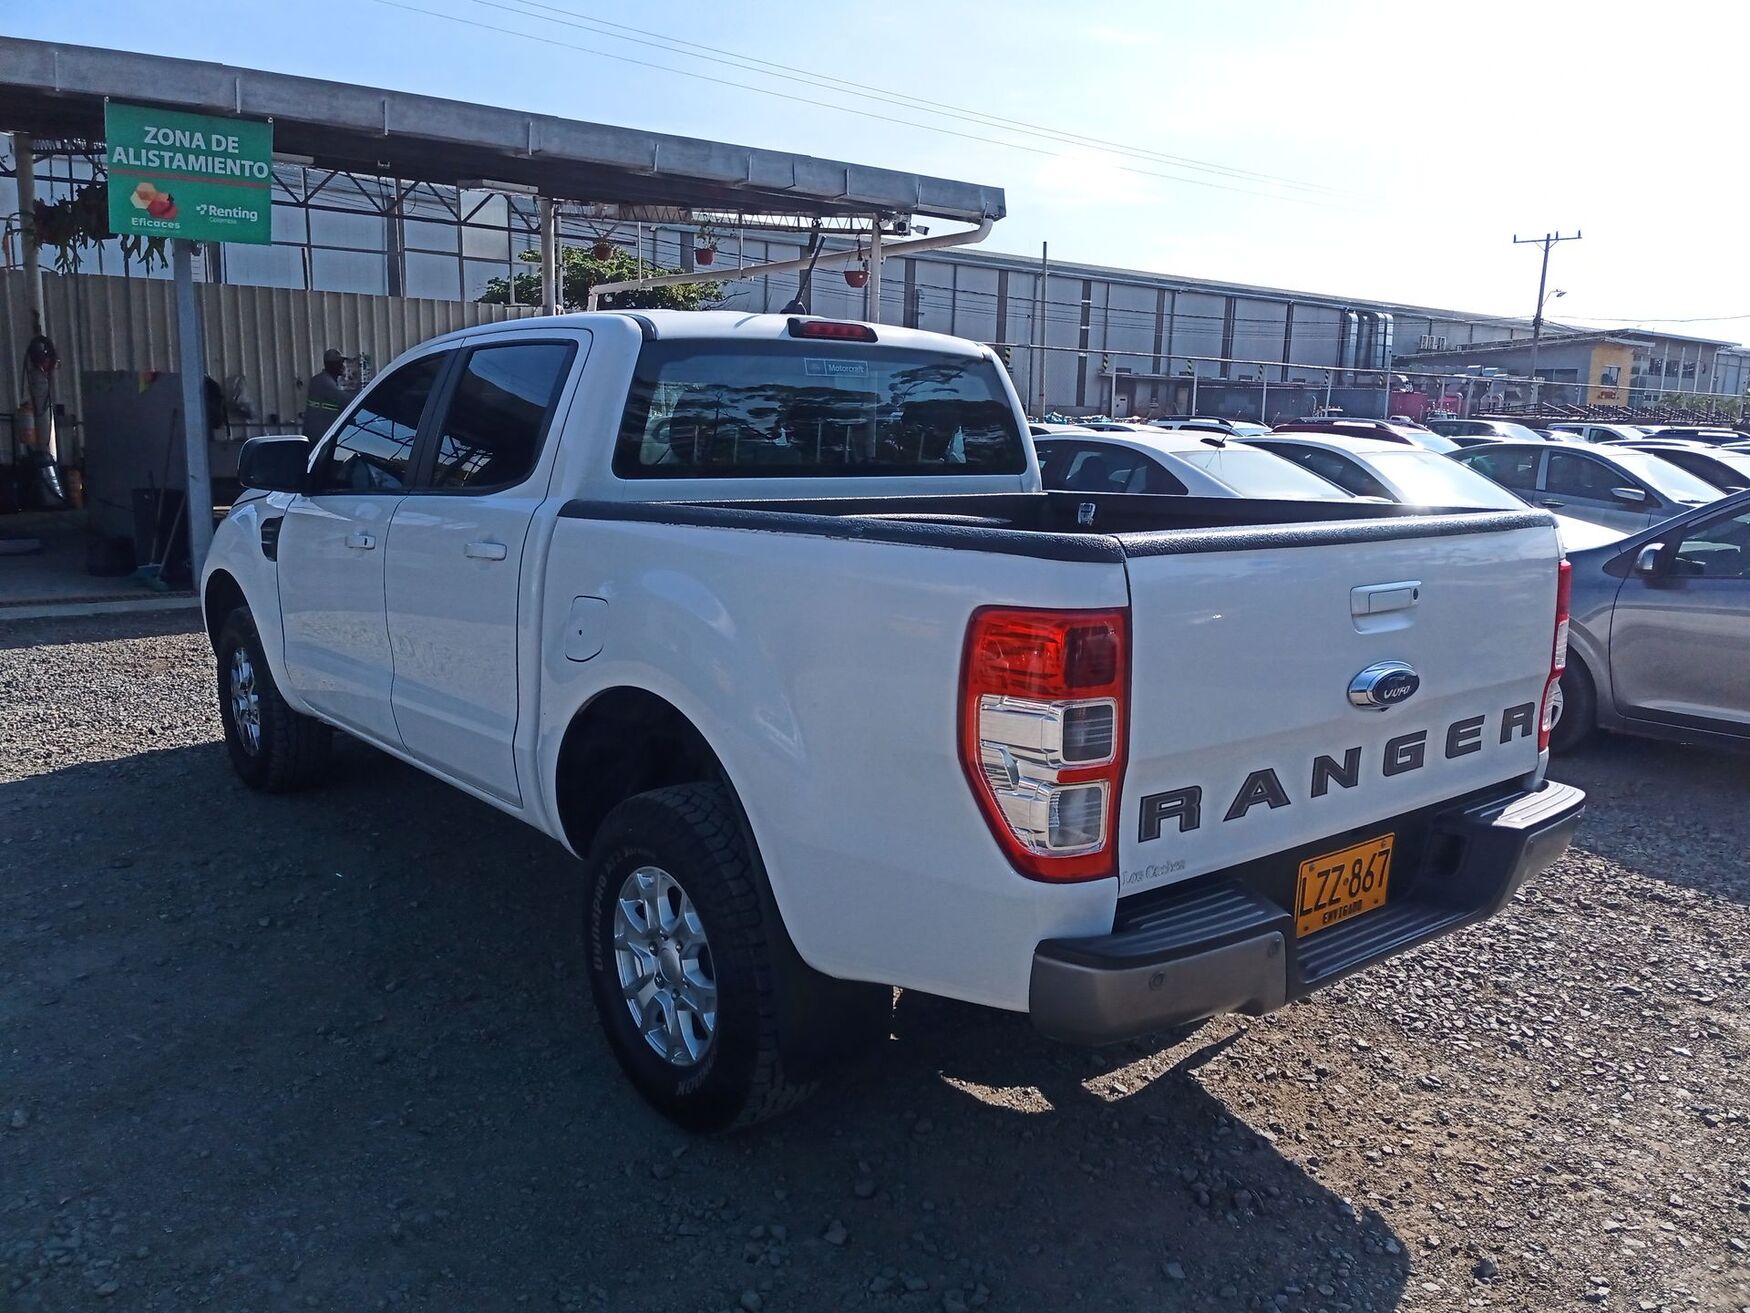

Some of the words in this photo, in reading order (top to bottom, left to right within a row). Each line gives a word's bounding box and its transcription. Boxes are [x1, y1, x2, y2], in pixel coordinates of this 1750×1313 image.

[144, 126, 206, 150] ZONA
[211, 134, 239, 154] DE
[112, 146, 269, 179] ALISTAMIENTO
[131, 217, 181, 230] Eficaces
[209, 204, 258, 222] Renting
[1138, 701, 1536, 843] RANGER
